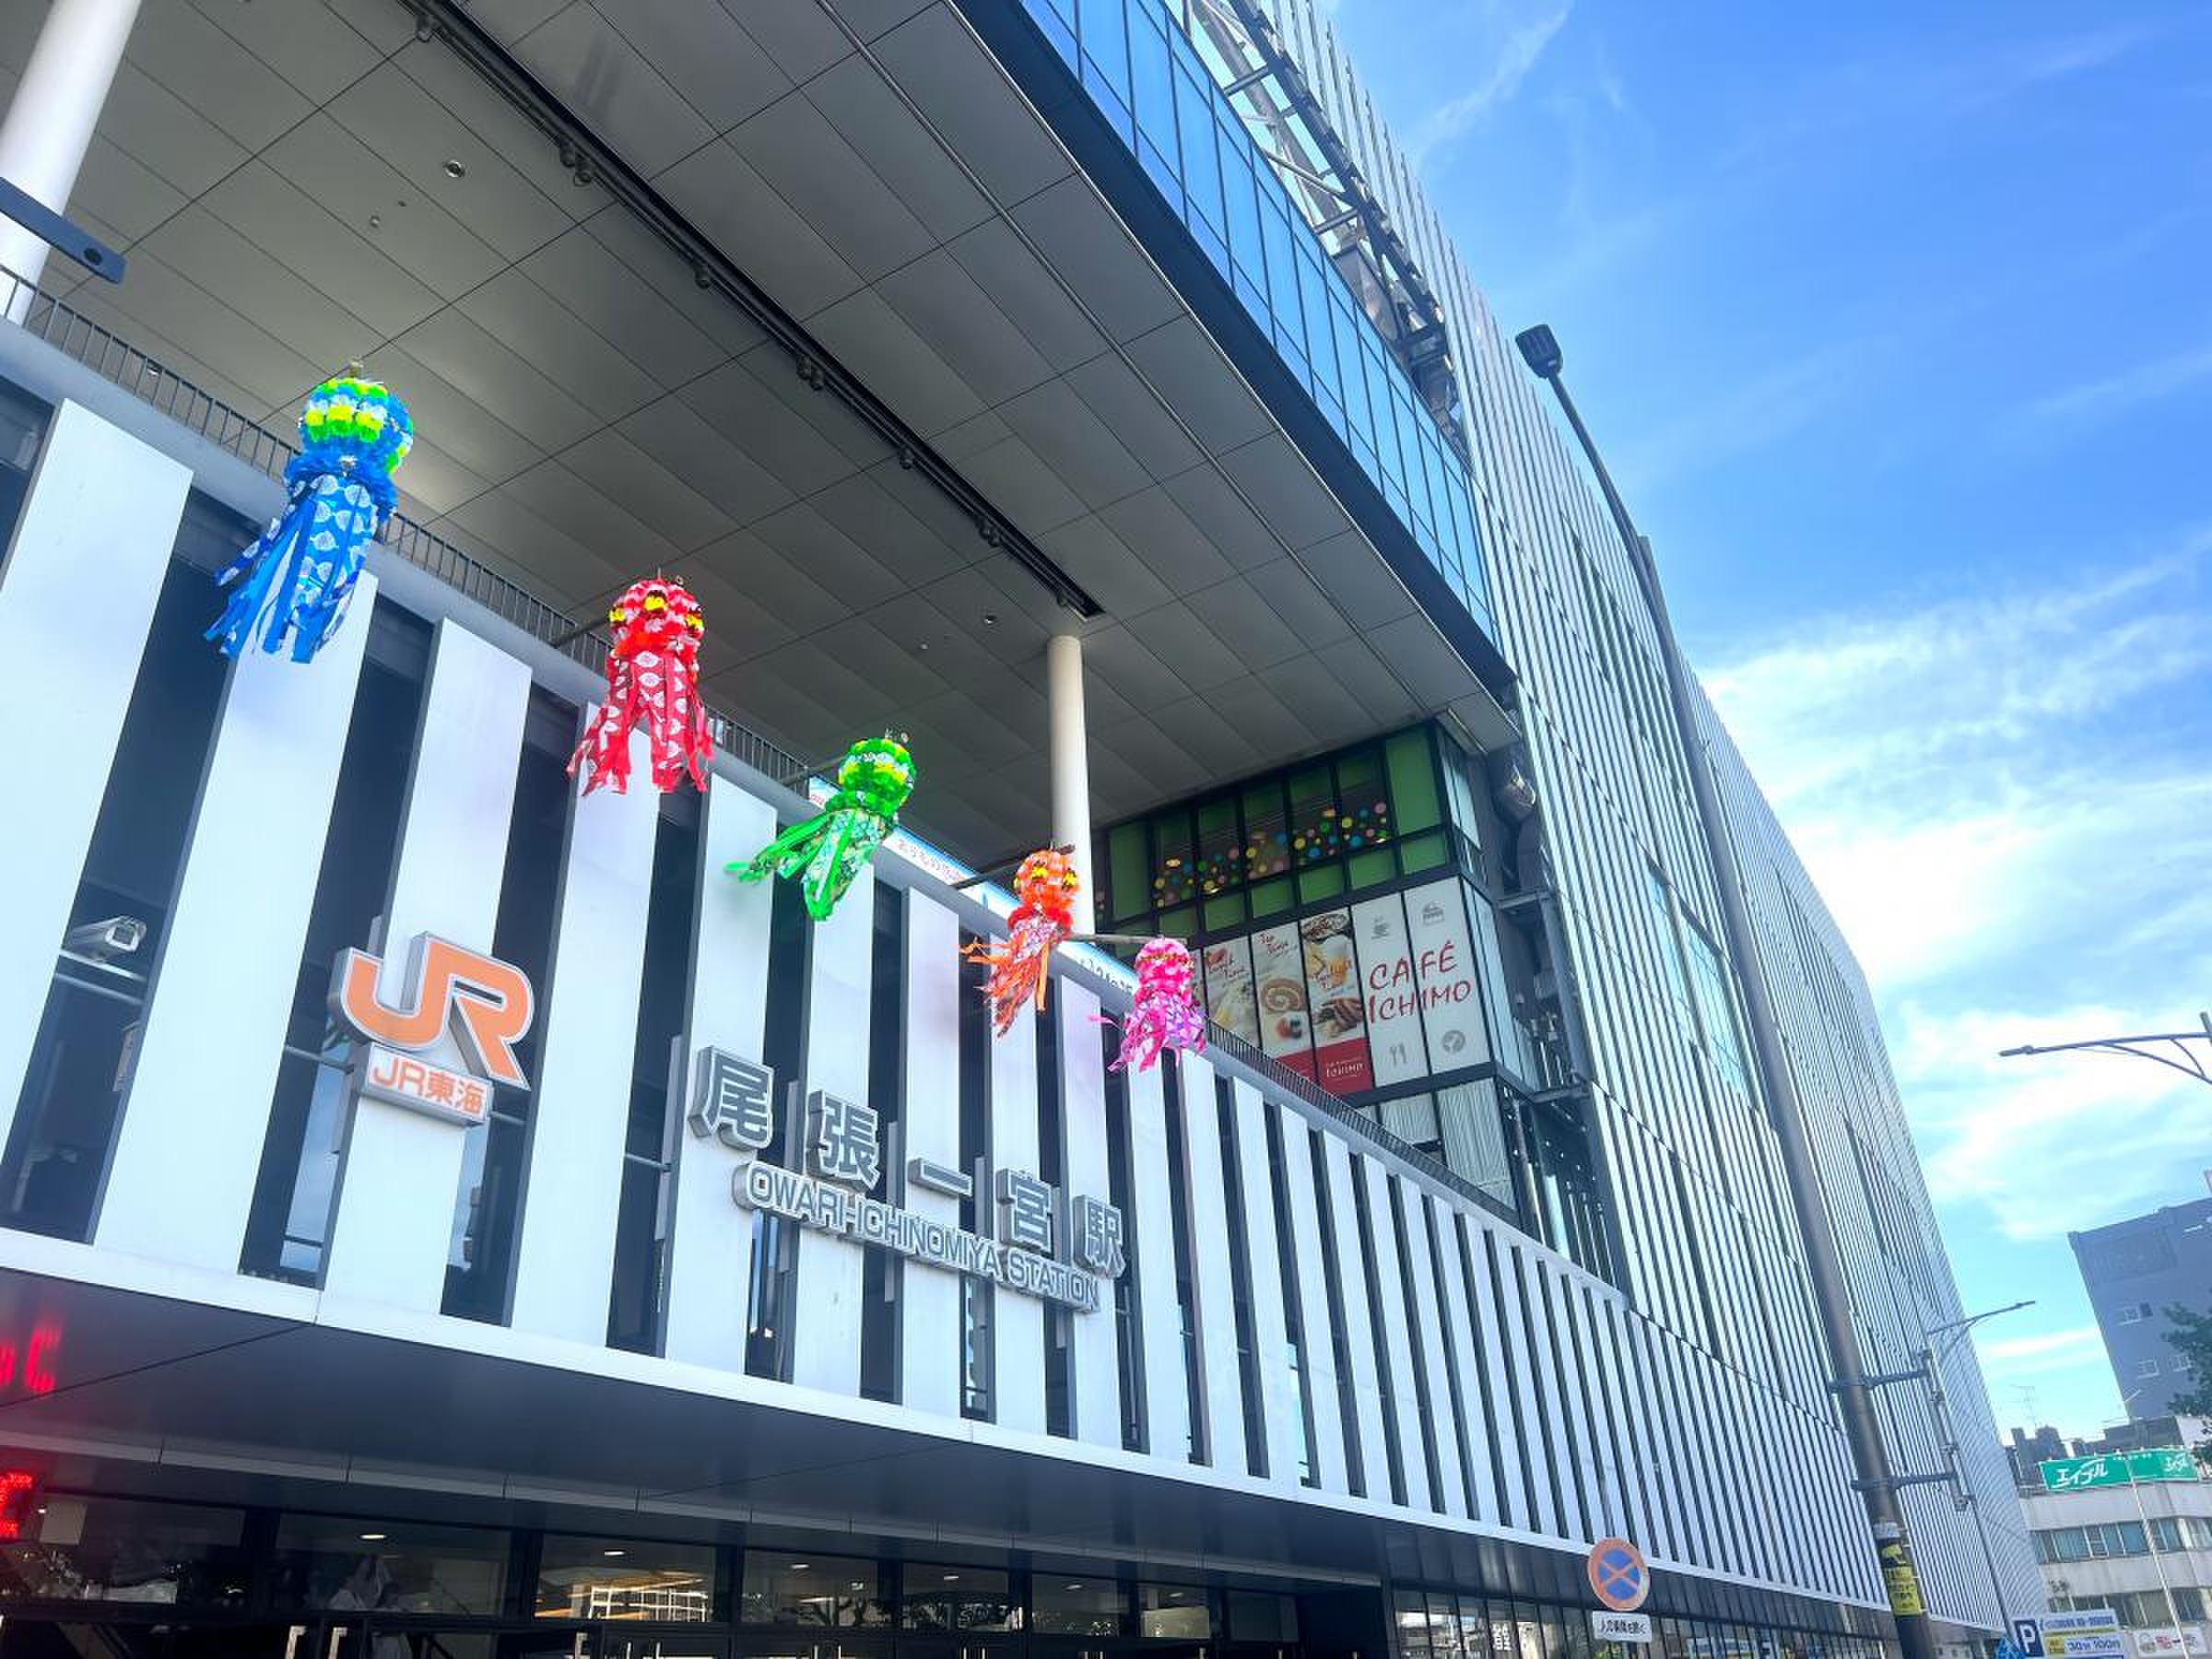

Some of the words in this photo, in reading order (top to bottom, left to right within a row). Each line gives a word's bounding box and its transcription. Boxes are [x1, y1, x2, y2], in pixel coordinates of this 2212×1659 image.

[1370, 939, 1457, 990] CAFÉ
[341, 934, 535, 1090] JR
[1368, 980, 1471, 1024] ICHIMO
[371, 1057, 484, 1115] JR東海
[695, 1047, 1125, 1277] 尾張一宮駅
[750, 1164, 1002, 1279] OWARI-ICHINOMIYA
[1008, 1249, 1100, 1311] STATION
[2051, 1458, 2109, 1488] エイブル
[2019, 1624, 2036, 1653] P
